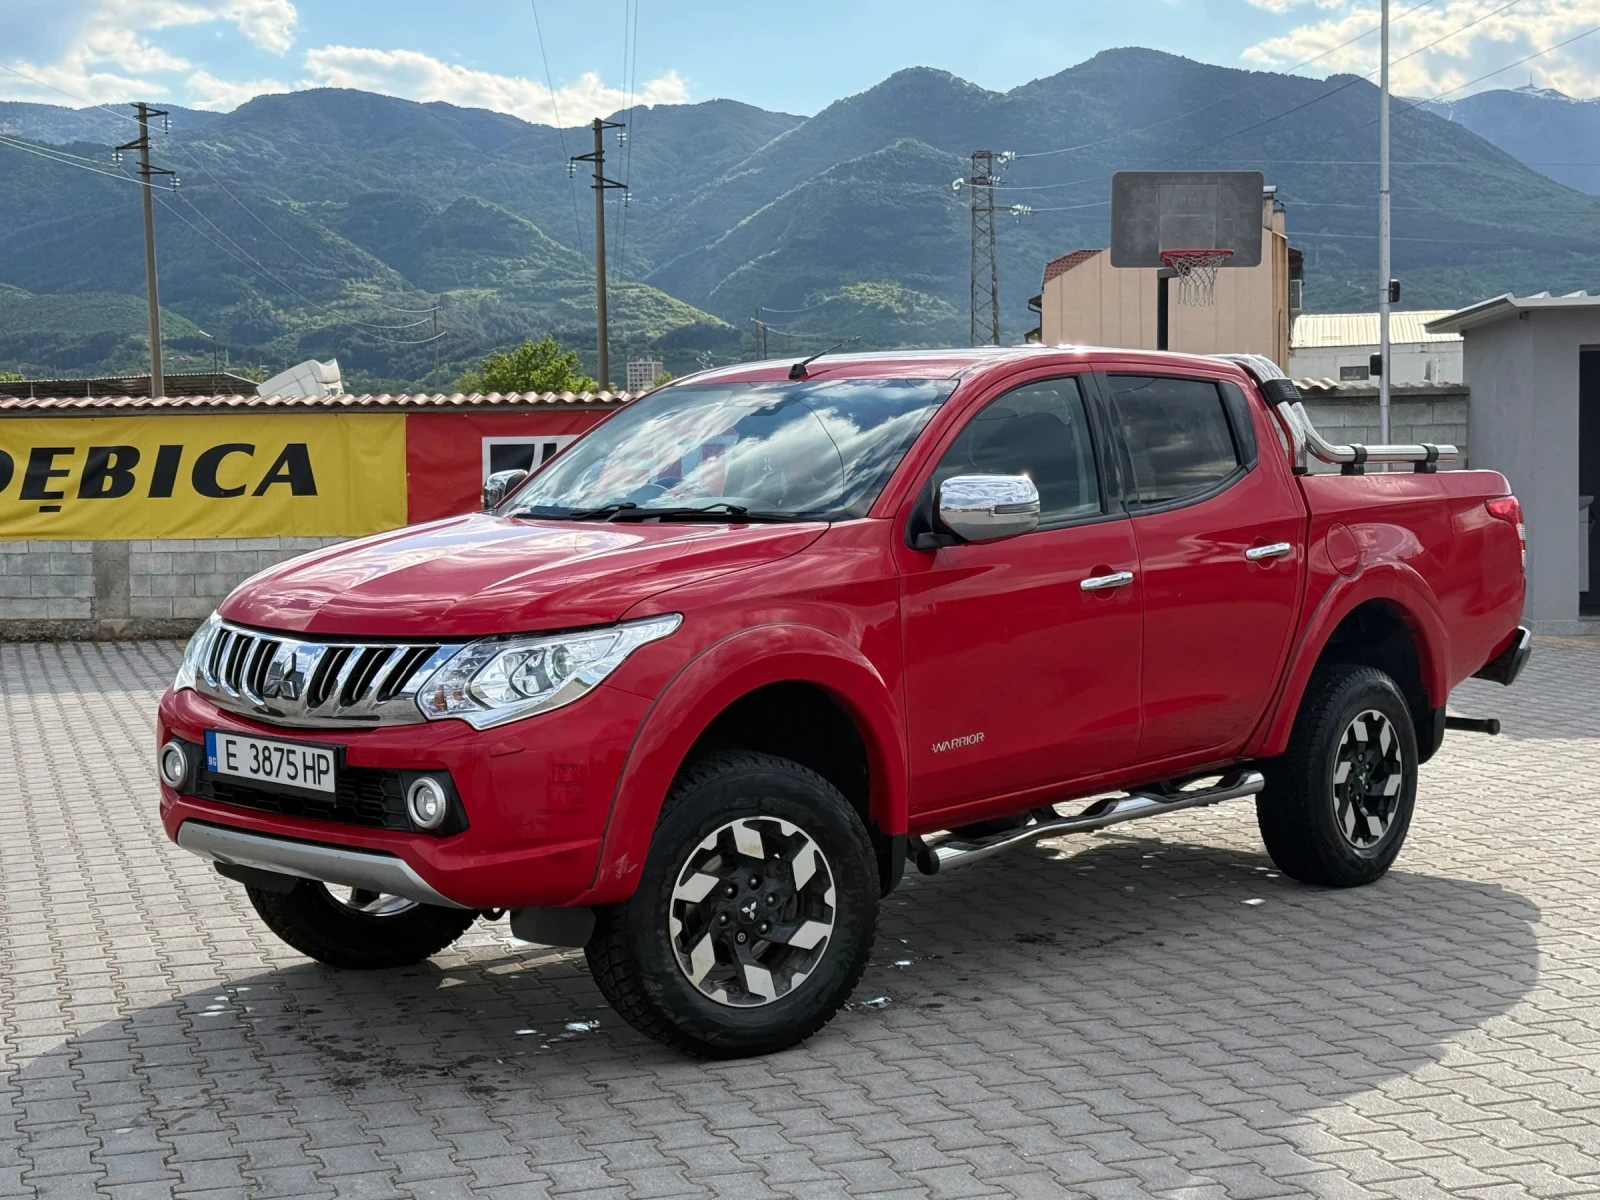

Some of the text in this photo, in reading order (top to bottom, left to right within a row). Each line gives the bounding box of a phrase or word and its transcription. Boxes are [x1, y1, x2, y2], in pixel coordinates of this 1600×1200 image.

[931, 731, 985, 754] WARRIOR
[208, 756, 217, 766] BG
[225, 739, 239, 771] E
